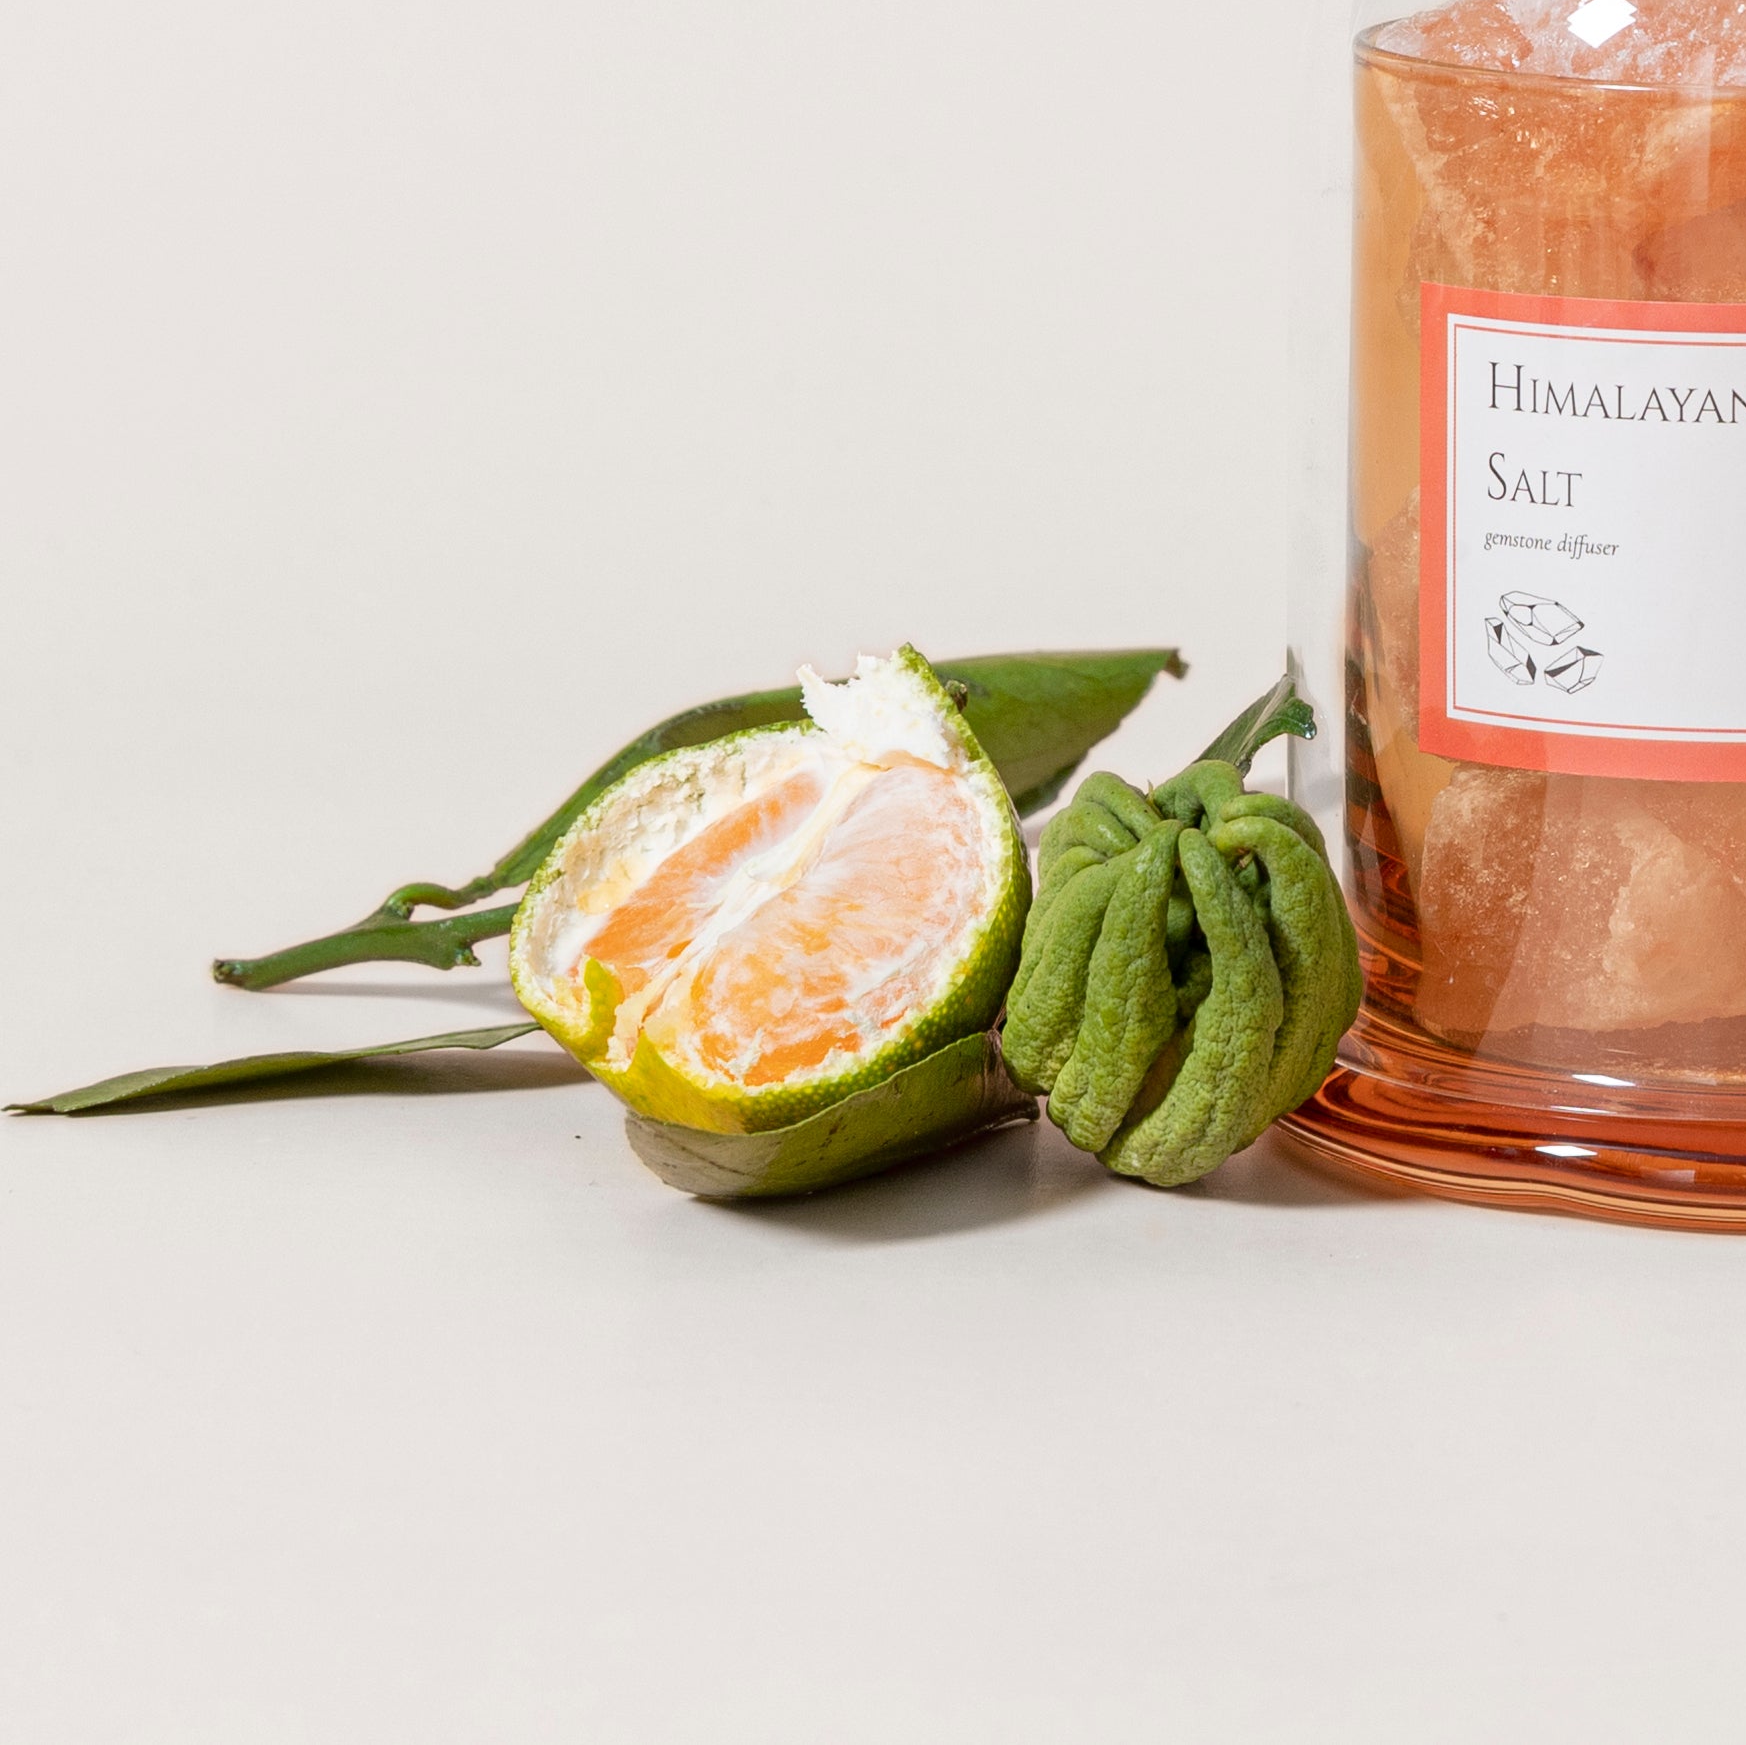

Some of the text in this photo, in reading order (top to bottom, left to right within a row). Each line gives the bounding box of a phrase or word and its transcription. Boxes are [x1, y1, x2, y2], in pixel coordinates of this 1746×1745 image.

[1487, 451, 1583, 508] SALT
[1483, 531, 1620, 560] gemstone diffuser
